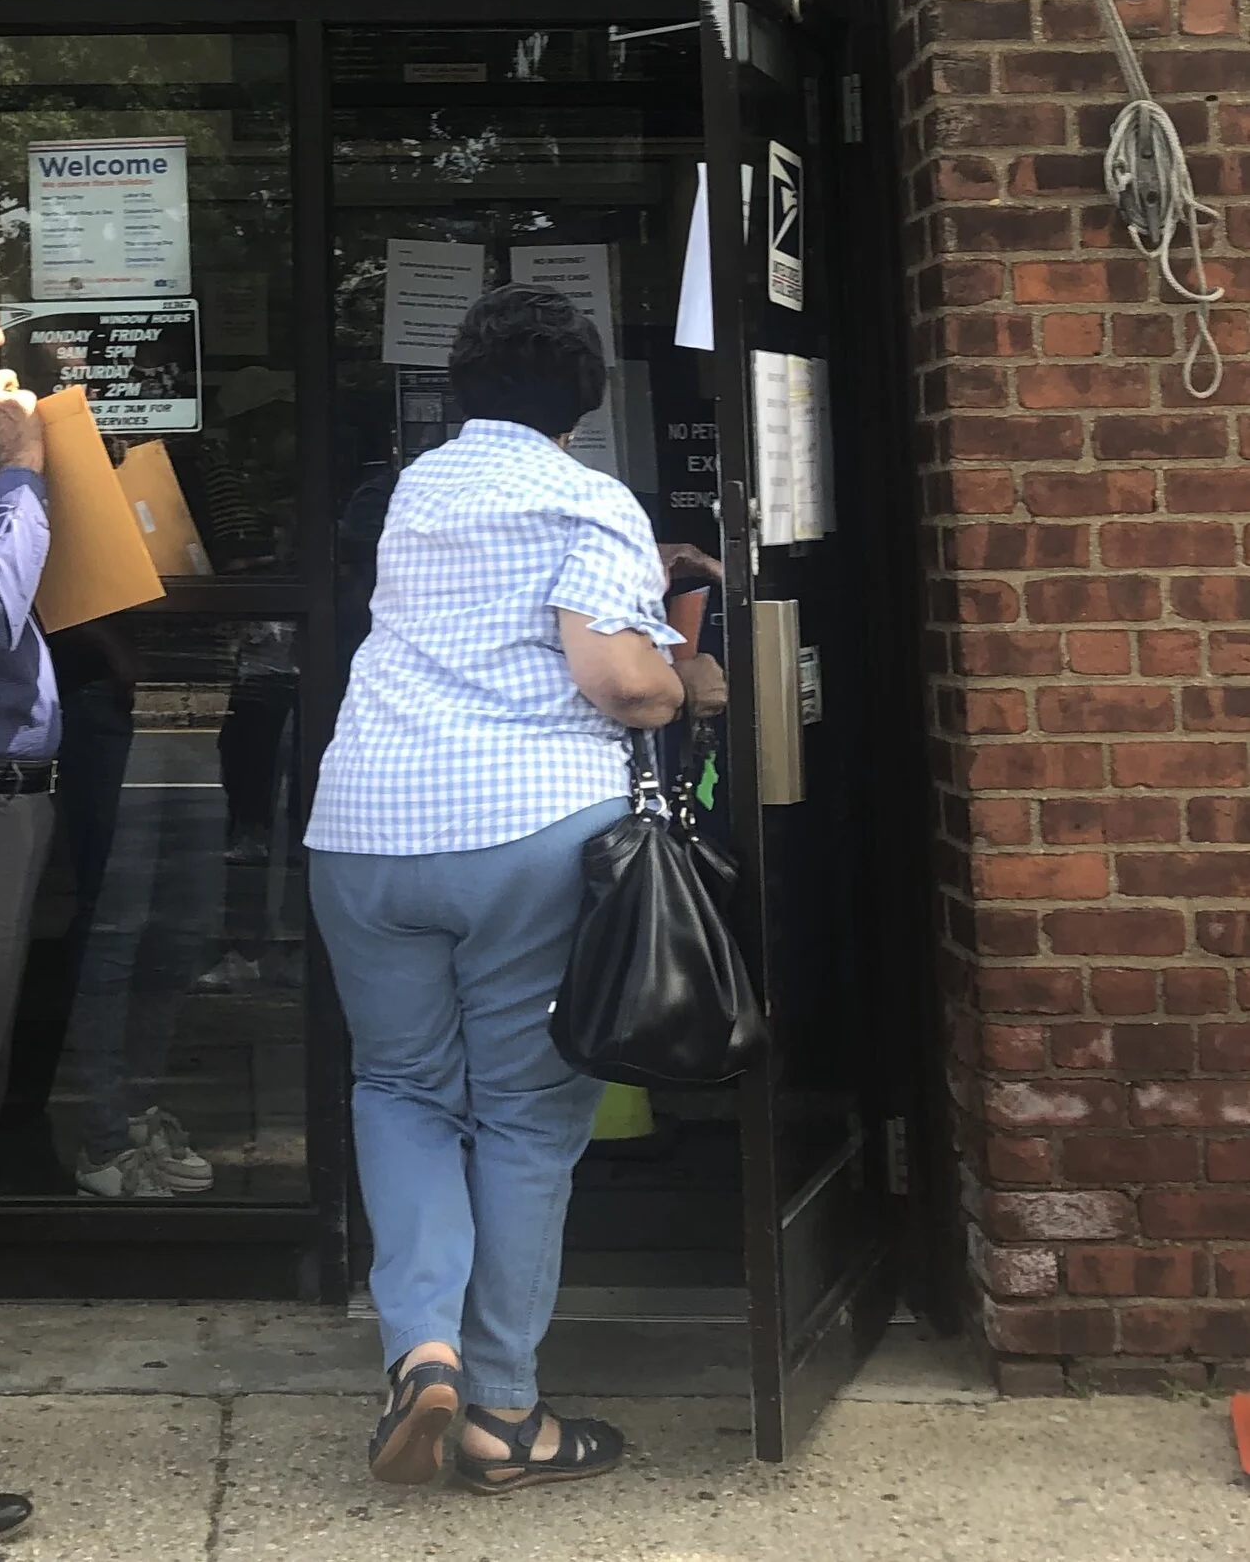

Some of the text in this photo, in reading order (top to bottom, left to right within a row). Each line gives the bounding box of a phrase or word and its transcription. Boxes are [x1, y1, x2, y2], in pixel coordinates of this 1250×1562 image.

[38, 155, 168, 178] Welcome
[100, 313, 191, 324] WINDOW HOURS
[30, 330, 94, 344] MONDAY
[110, 328, 163, 342] FRIDAY
[56, 346, 89, 359] 9AM
[104, 345, 138, 358] 5PM
[60, 364, 134, 380] SATURDAY
[104, 382, 142, 396] 2PM
[106, 405, 120, 414] AT
[124, 404, 146, 413] 7AM
[150, 404, 173, 412] FOR
[96, 416, 149, 426] SERVICES
[668, 423, 688, 439] NO
